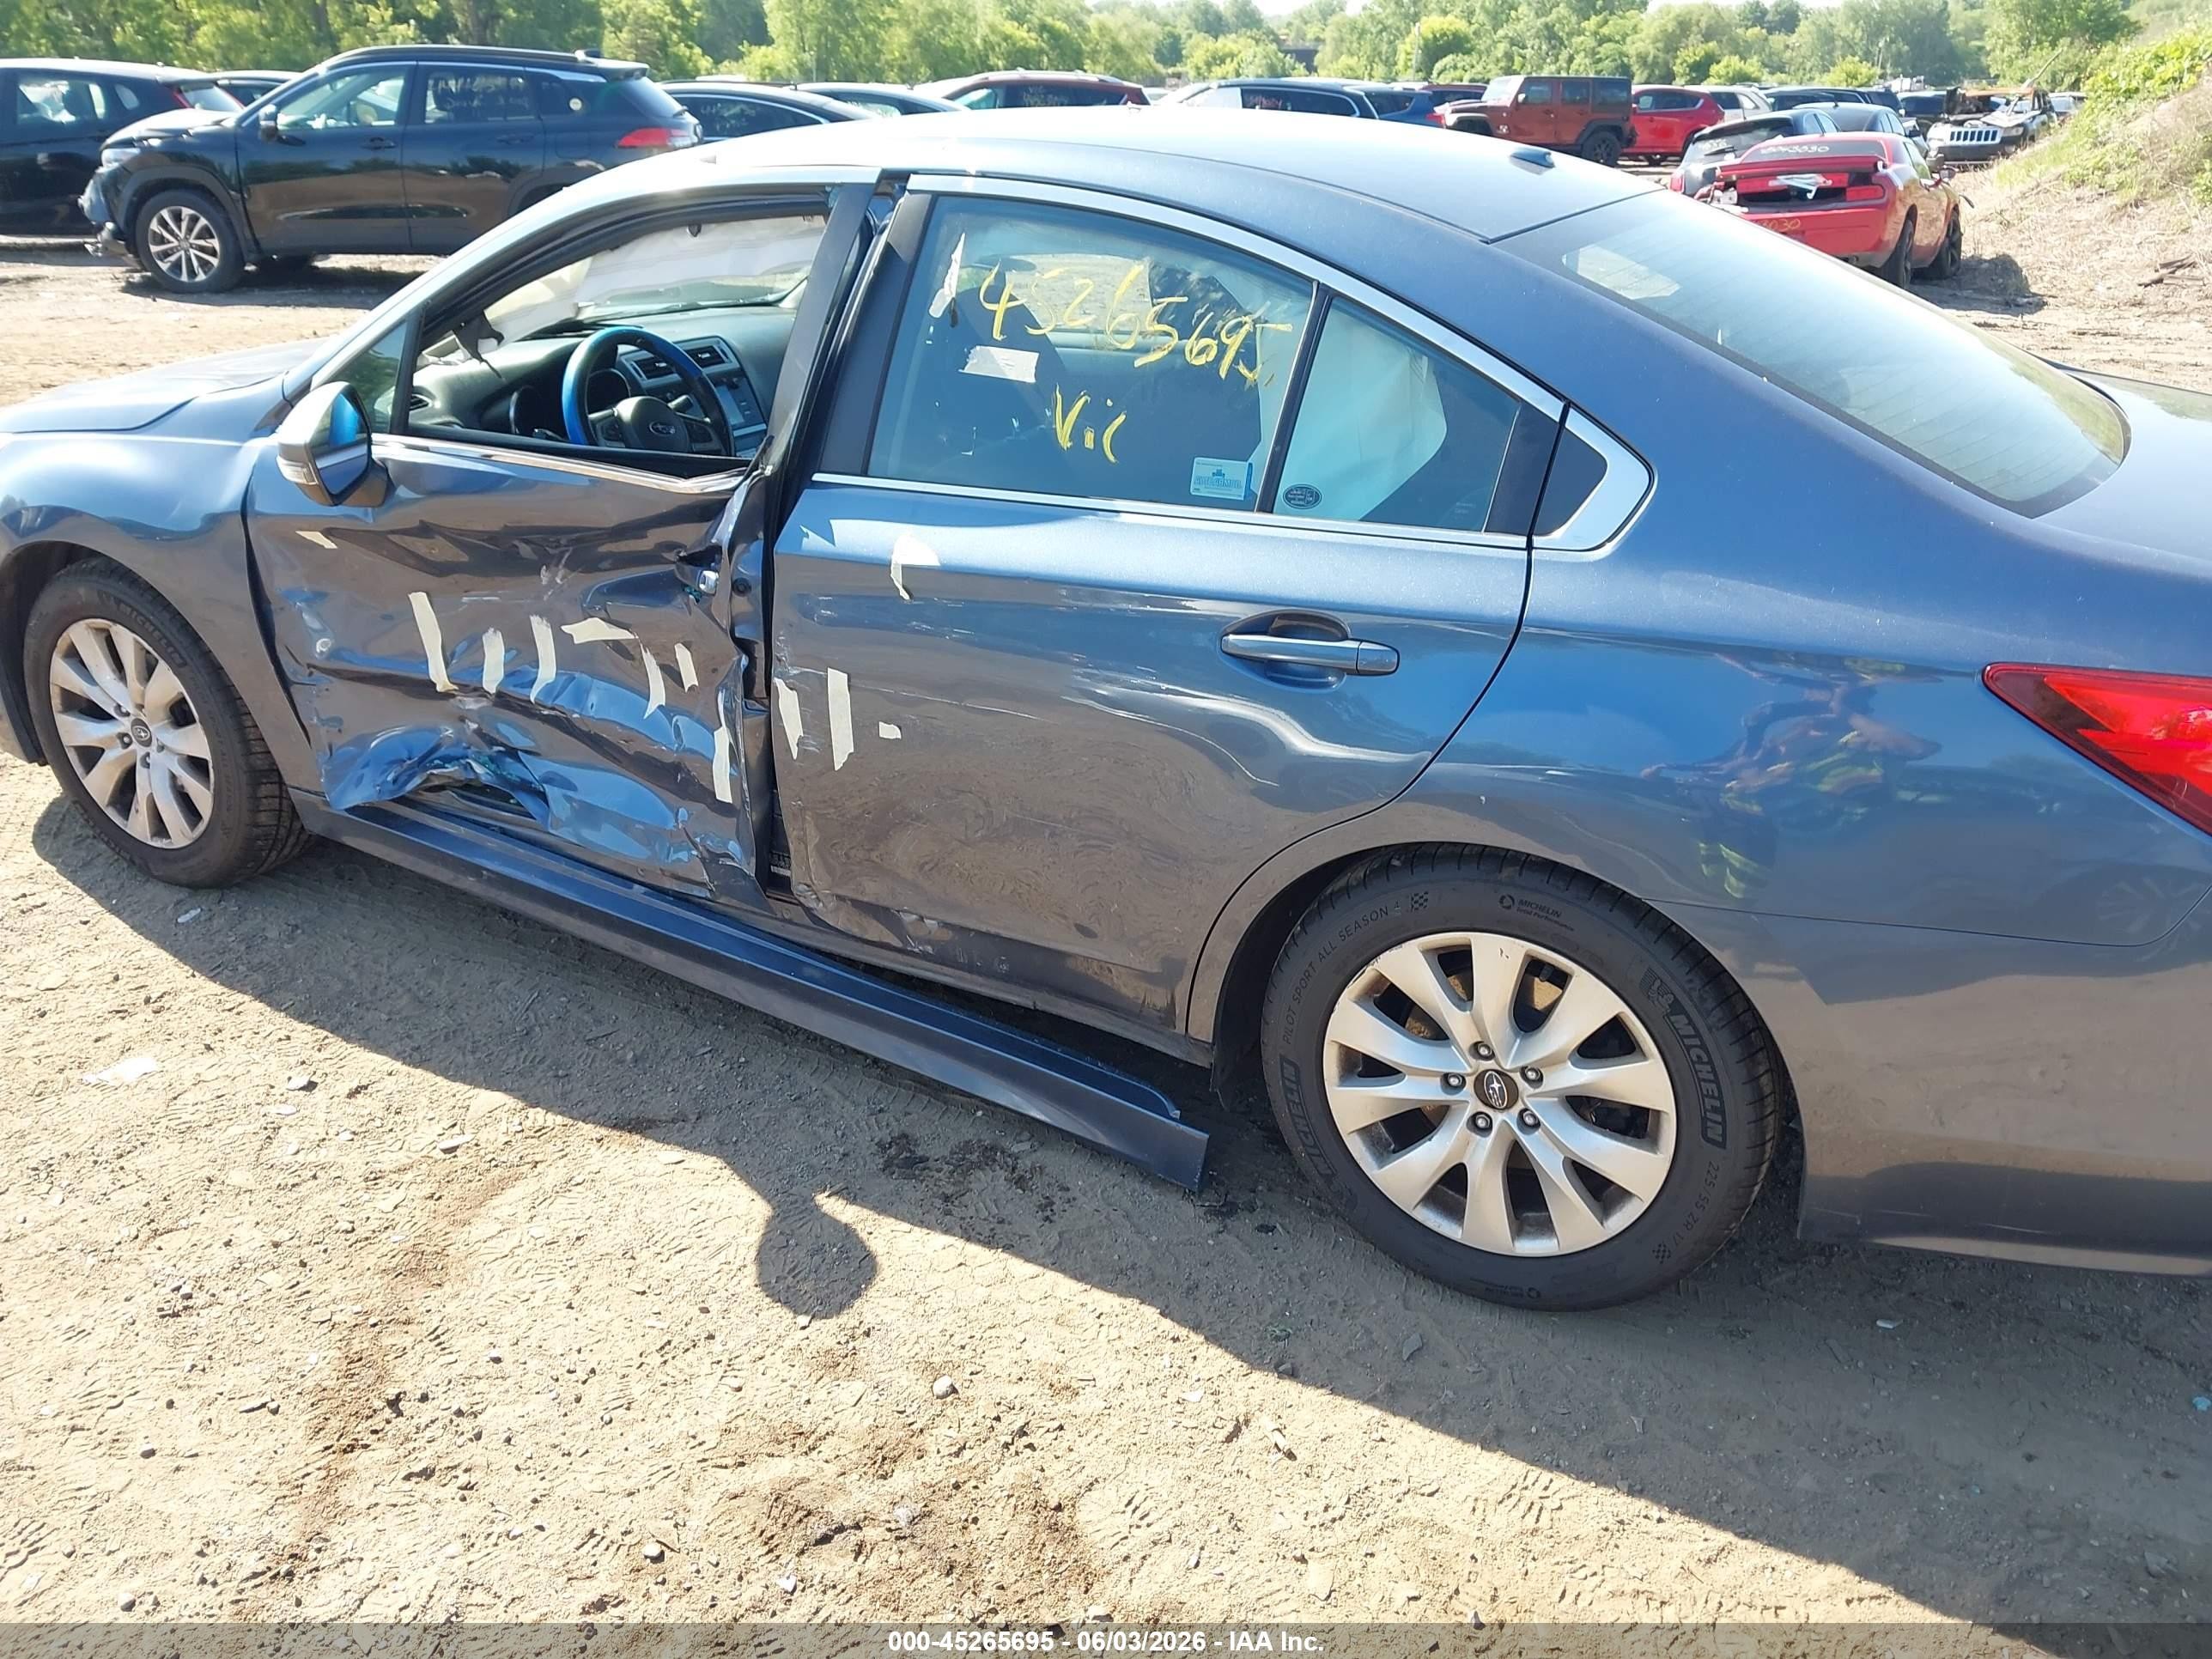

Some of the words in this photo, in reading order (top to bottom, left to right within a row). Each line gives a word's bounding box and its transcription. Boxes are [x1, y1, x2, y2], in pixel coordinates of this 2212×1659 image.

[979, 259, 1292, 389] 45265695
[1517, 899, 1562, 918] MICHELIN
[1282, 1007, 1298, 1045] PILOT
[1291, 961, 1318, 1004] SPORT
[1318, 940, 1338, 963] ALL
[1338, 906, 1389, 942] SEASON
[1282, 1058, 1334, 1175] MICHELIN
[1669, 1013, 1723, 1145] MICHELIN
[1694, 1160, 1720, 1211] 225/55
